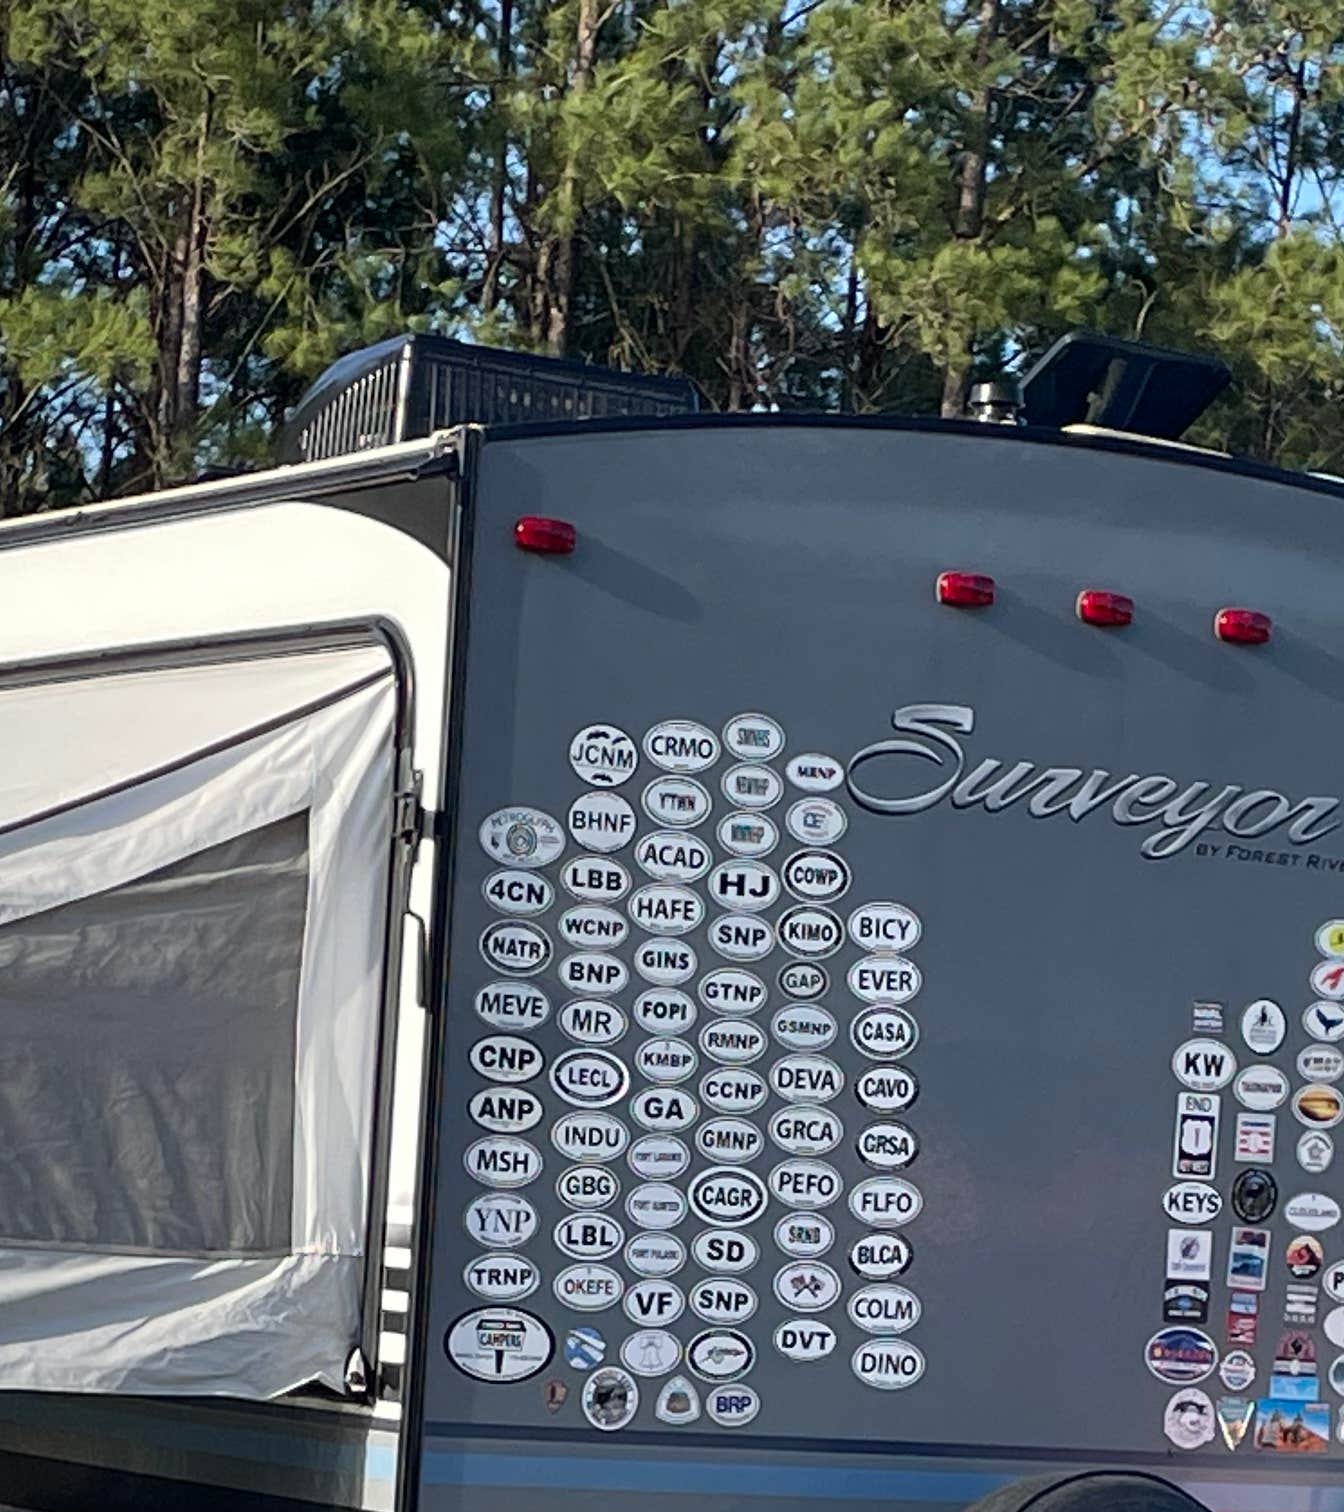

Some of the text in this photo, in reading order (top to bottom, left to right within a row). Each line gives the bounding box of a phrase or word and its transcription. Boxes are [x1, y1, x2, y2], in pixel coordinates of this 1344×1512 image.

[573, 743, 633, 768] JCNM
[651, 736, 713, 758] CRMO
[847, 704, 1343, 859] Surveyor
[572, 811, 631, 832] BHNF
[644, 843, 704, 868] ACAD
[1226, 845, 1302, 866] FOREST
[572, 868, 621, 890] LBB
[719, 873, 769, 897] HJ
[490, 880, 544, 904] 4CN
[638, 898, 694, 921] HAFE
[566, 918, 623, 936] WCNP
[719, 925, 766, 946] SNP
[789, 922, 833, 942] KIMO
[859, 917, 910, 940] BICY
[493, 937, 540, 958] NATR
[643, 952, 689, 970] GINS
[569, 962, 620, 984] BNP
[786, 973, 820, 988] GAP
[859, 970, 912, 991] EVER
[706, 983, 761, 1002] GTNP
[481, 993, 543, 1018] MEVE
[643, 1002, 686, 1020] FOPI
[573, 1009, 611, 1034] MR
[863, 1021, 905, 1042] CASA
[708, 1032, 759, 1049] RMNP
[479, 1045, 535, 1070] CNP
[644, 1052, 691, 1067] KMBP
[1184, 1052, 1224, 1077] KW
[778, 1068, 834, 1090] DEVA
[864, 1078, 908, 1097] CAVO
[706, 1082, 761, 1099] CCNP
[479, 1098, 534, 1120] ANP
[645, 1097, 684, 1119] GA
[565, 1127, 620, 1147] INDU
[703, 1130, 756, 1150] GMNP
[777, 1119, 833, 1142] GRCA
[864, 1134, 909, 1155] GRSA
[477, 1149, 529, 1173] MSH
[567, 1176, 611, 1194] GBG
[778, 1172, 834, 1195] PEFO
[702, 1187, 752, 1207] CAGR
[861, 1192, 912, 1212] FLFO
[1168, 1193, 1219, 1213] KEYS
[475, 1208, 530, 1233] YNP
[567, 1225, 613, 1246] LBL
[707, 1238, 744, 1262] SD
[858, 1246, 901, 1264] BLCA
[474, 1269, 531, 1285] TRNP
[565, 1279, 613, 1295] OKEFE
[636, 1292, 672, 1315] VF
[700, 1290, 748, 1311] SNP
[856, 1299, 912, 1320] COLM
[782, 1331, 830, 1350] DVT
[861, 1353, 916, 1375] DINO
[716, 1396, 751, 1413] BRP
